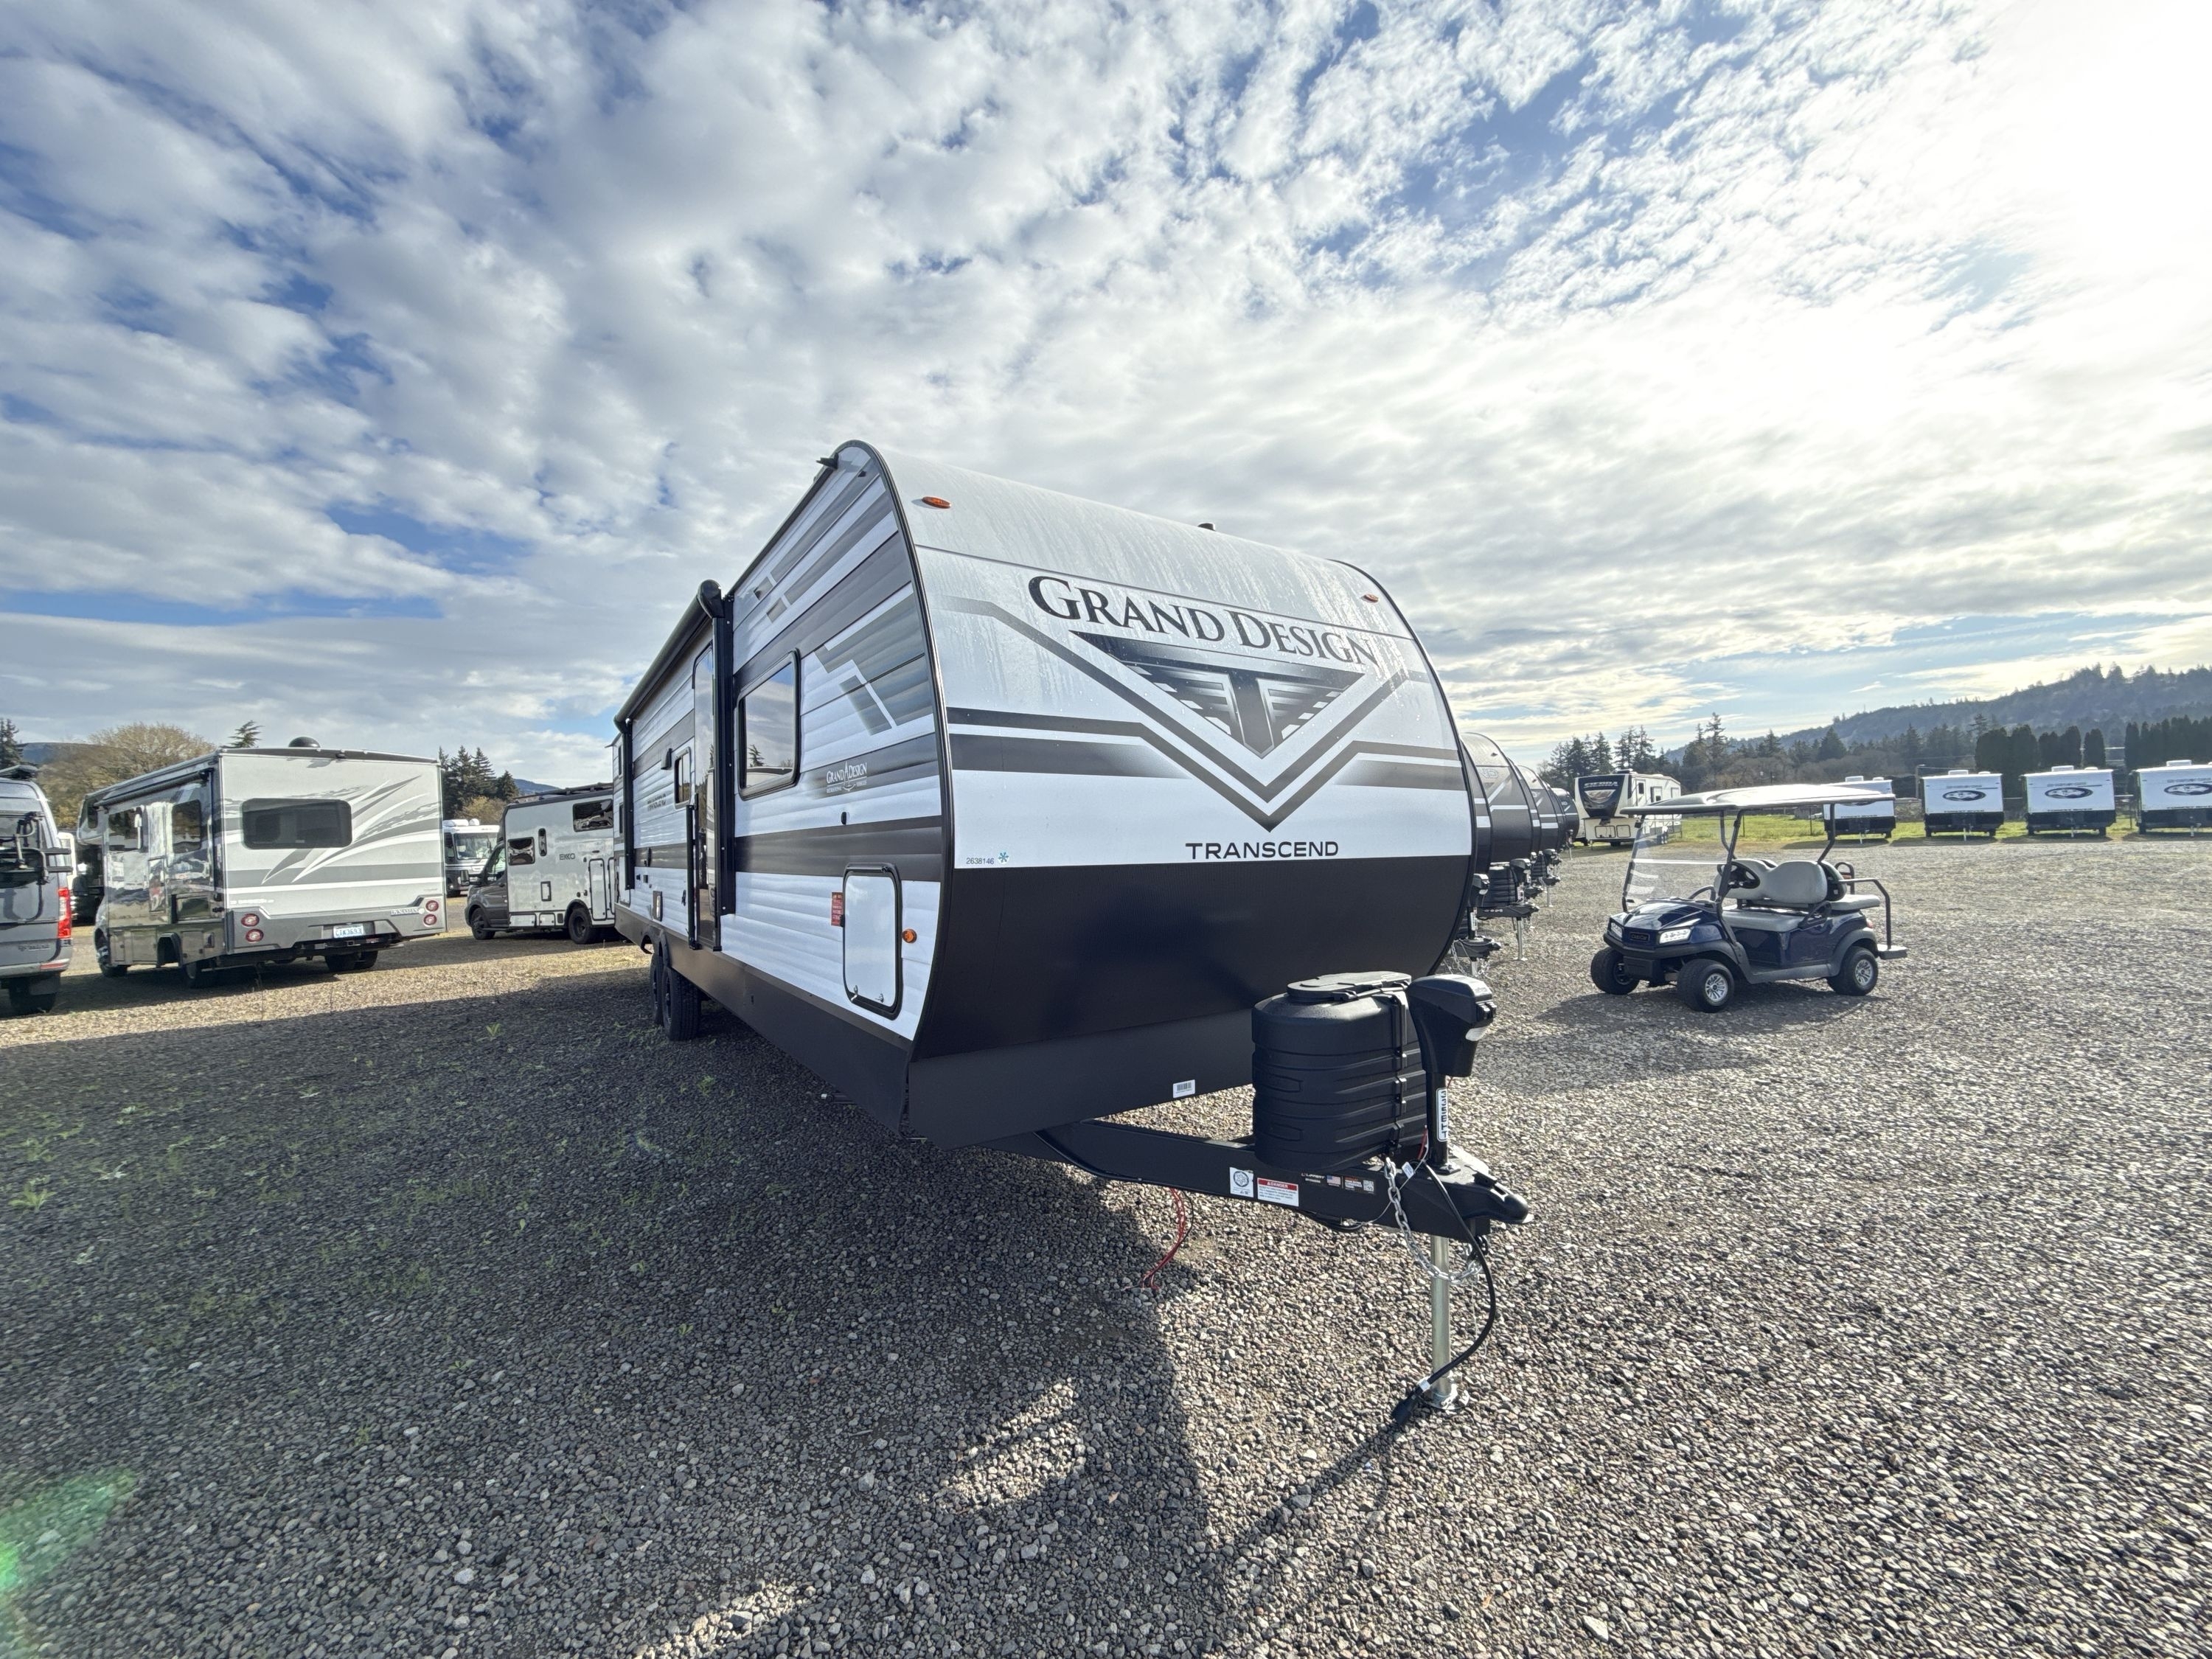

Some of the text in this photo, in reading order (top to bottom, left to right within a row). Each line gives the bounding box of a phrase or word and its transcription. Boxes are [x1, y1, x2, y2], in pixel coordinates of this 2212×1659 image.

[1028, 575, 1380, 668] GRAND DESIGN
[827, 769, 844, 784] GRAND
[849, 762, 867, 779] DESIGN
[1185, 841, 1339, 860] TRANSCEND
[966, 857, 995, 865] 2638146
